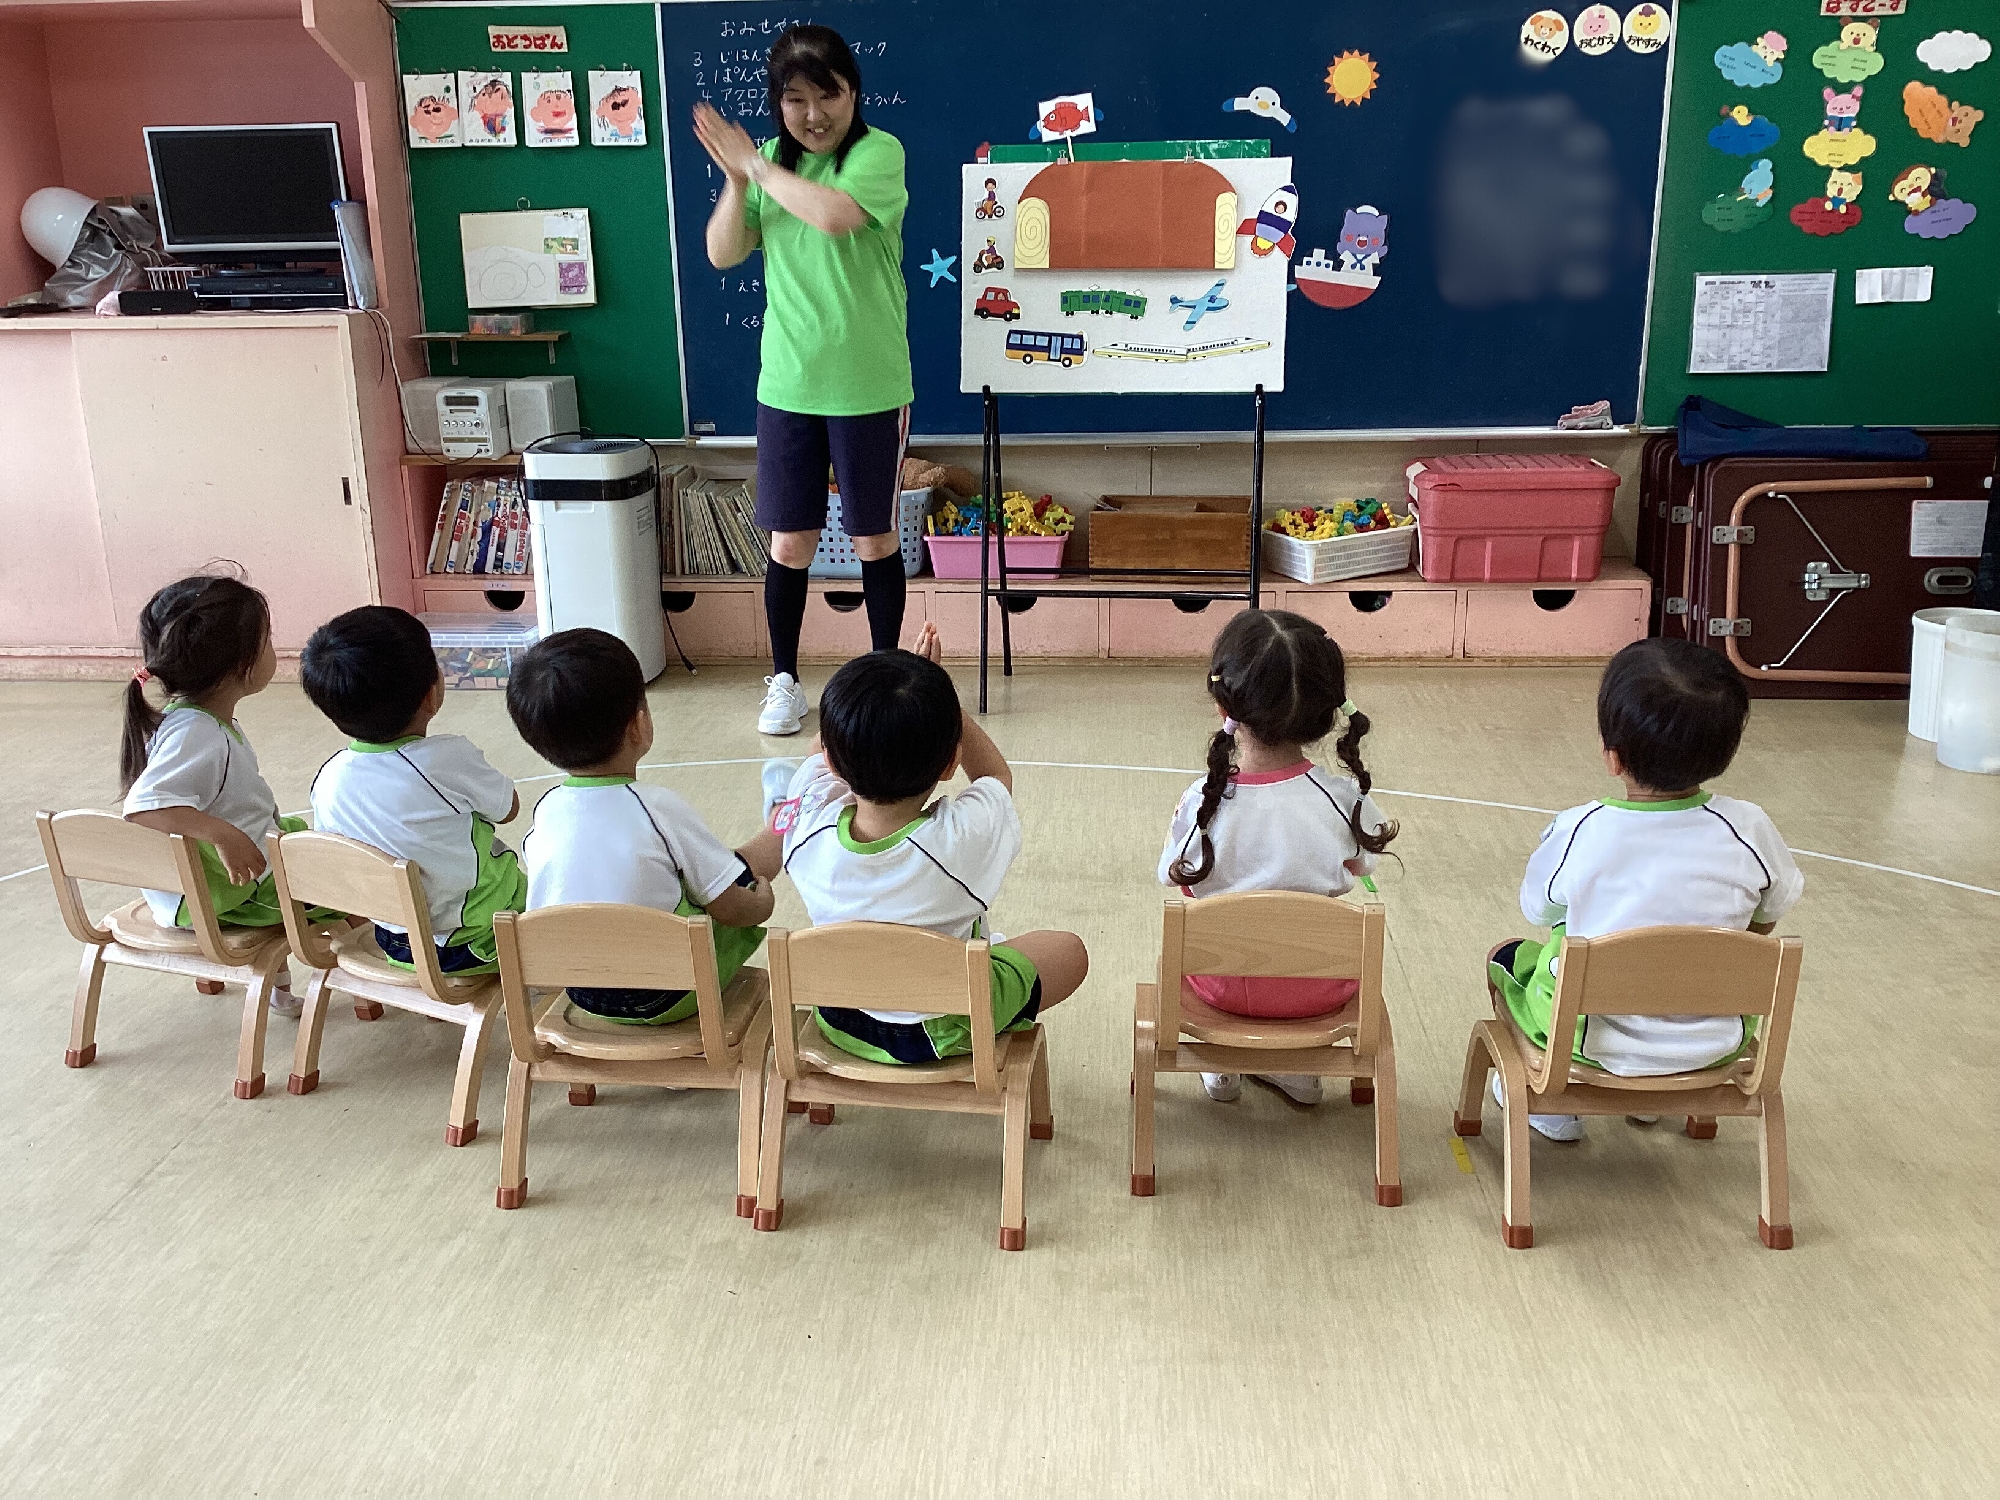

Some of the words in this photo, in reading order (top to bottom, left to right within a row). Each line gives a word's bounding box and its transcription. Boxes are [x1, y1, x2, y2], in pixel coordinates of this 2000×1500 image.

[492, 33, 564, 50] おとうばん
[1523, 34, 1560, 56] わくわく
[1578, 34, 1616, 49] おむかえ
[1626, 34, 1662, 49] おやすみ
[693, 52, 703, 67] 3
[696, 71, 706, 86] 2
[702, 89, 713, 101] 4
[859, 90, 907, 107] ょういん
